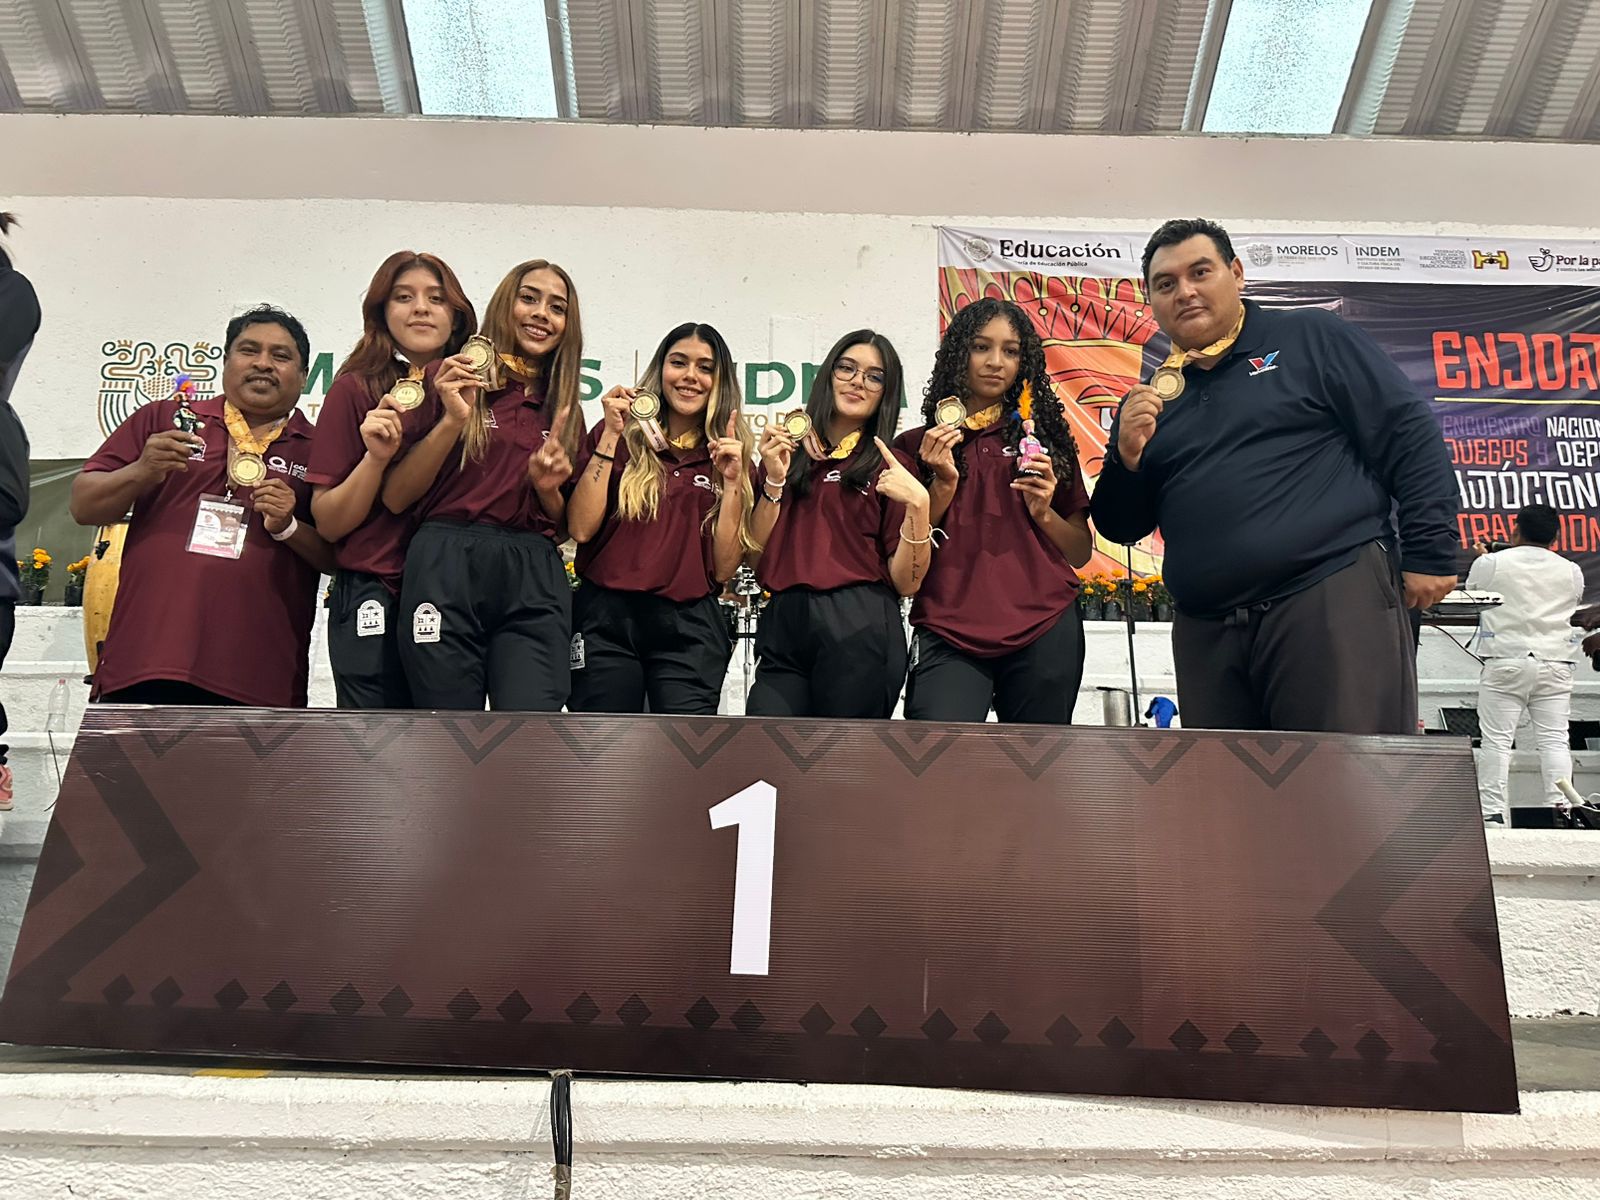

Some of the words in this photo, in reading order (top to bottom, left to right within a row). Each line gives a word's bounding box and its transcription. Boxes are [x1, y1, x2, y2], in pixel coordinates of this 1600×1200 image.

[999, 239, 1121, 258] Educación
[1276, 245, 1338, 256] MORELOS
[1355, 246, 1400, 257] INDEM
[1556, 255, 1577, 265] Por
[1579, 254, 1589, 266] la
[1442, 415, 1541, 437] ENCUENTRO
[1443, 438, 1529, 466] JUEGOS
[1556, 441, 1600, 467] DEP
[1456, 513, 1600, 552] TRAION
[708, 779, 777, 976] 1
